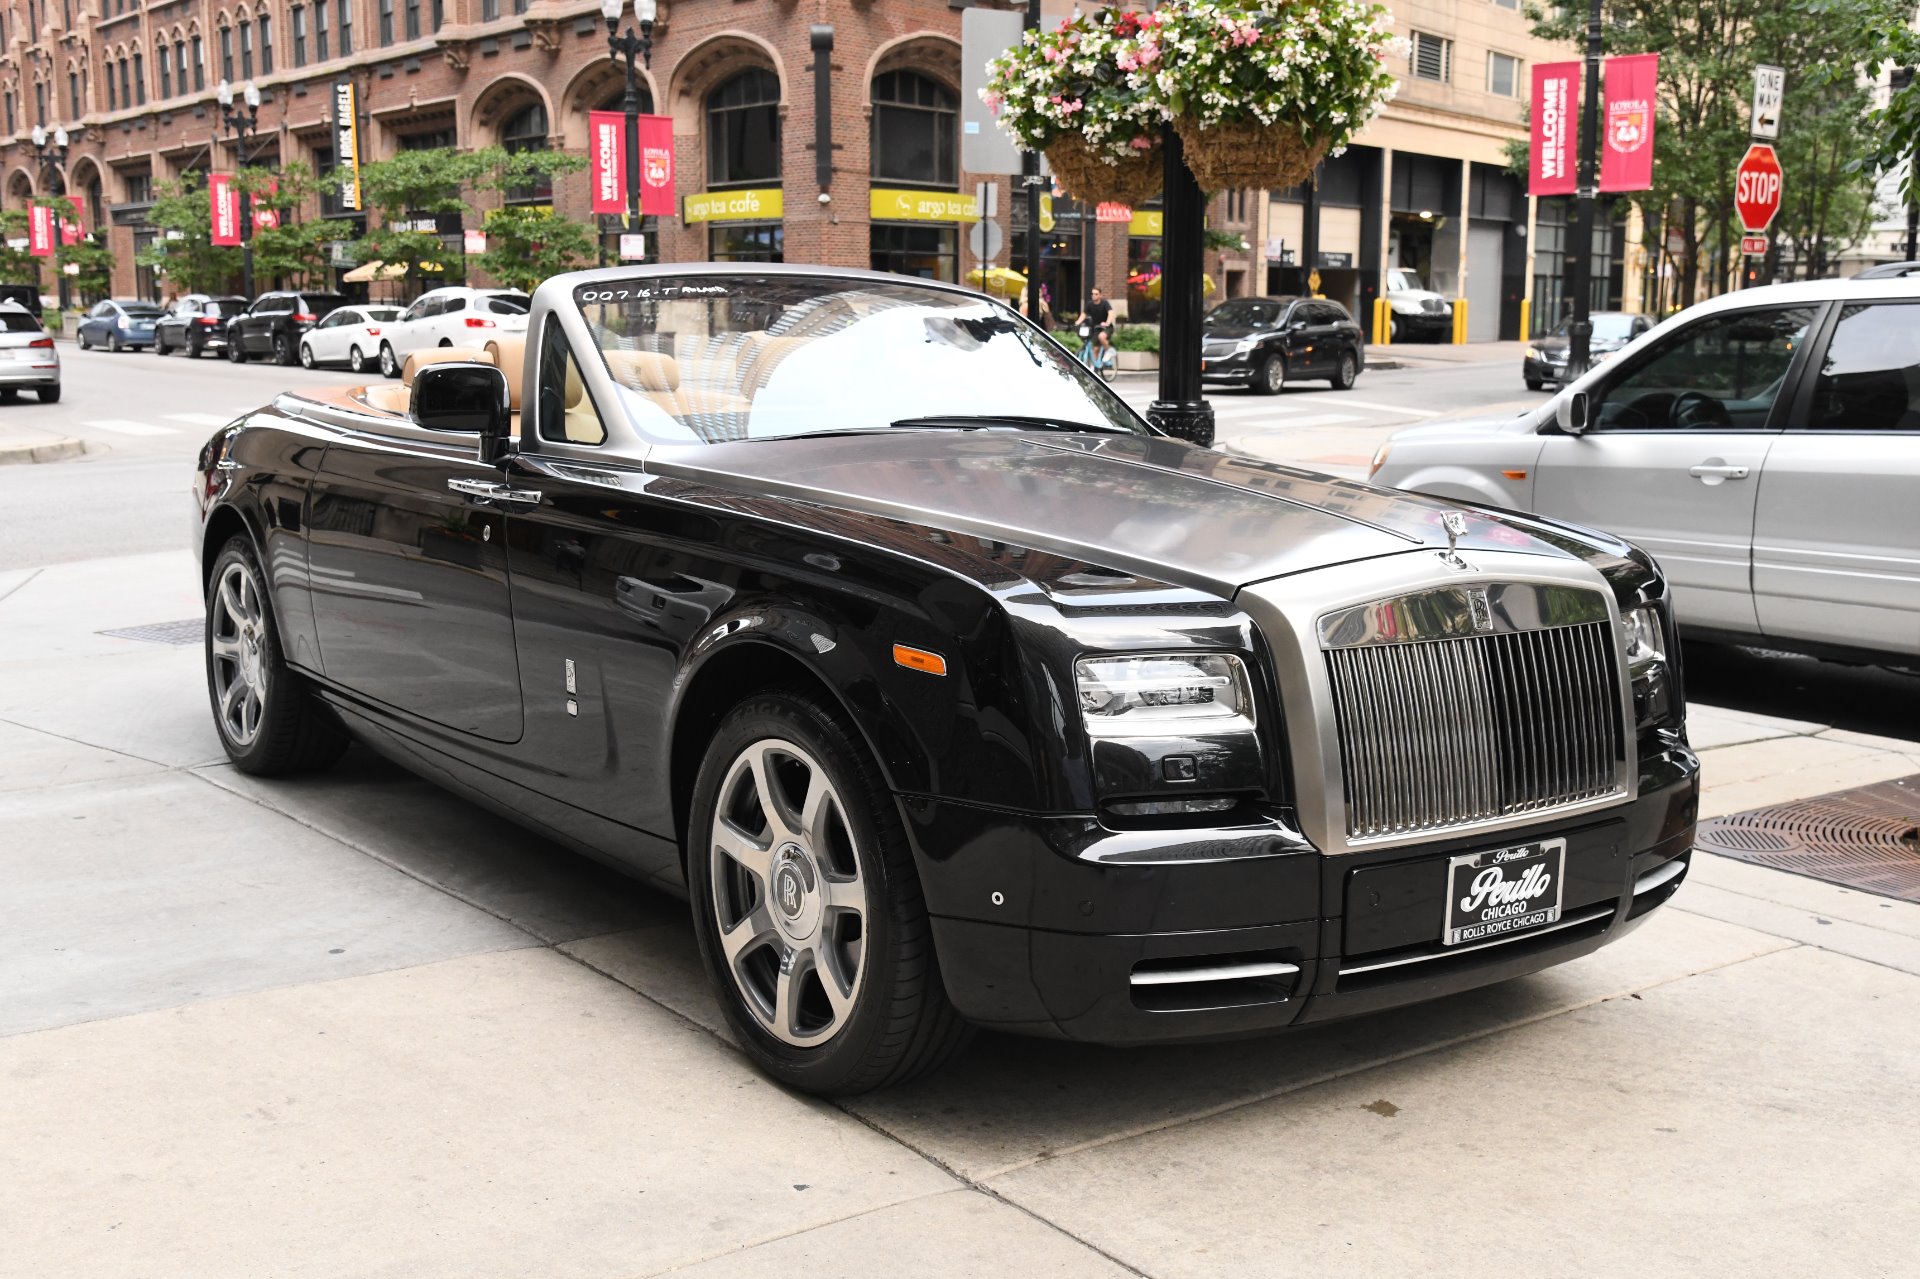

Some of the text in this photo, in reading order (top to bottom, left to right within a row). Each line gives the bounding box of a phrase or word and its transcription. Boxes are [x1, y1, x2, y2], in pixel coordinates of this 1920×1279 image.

[1760, 73, 1780, 91] ONE
[337, 84, 351, 126] BAGELS
[1610, 99, 1649, 111] LOYOLA
[1758, 93, 1778, 107] WAY
[1542, 78, 1559, 179] WELCOME
[1557, 78, 1568, 178] WATER TOWER CAMPUS
[598, 124, 613, 201] WELCOME
[643, 147, 670, 158] LOYOLA
[340, 159, 356, 208] EINSN
[1738, 169, 1779, 205] STOP
[216, 182, 229, 237] WELCOME
[729, 191, 760, 212] café
[918, 196, 978, 219] argo tea caf
[1743, 240, 1753, 251] ALL
[1492, 847, 1530, 864] Perillo
[1460, 863, 1551, 913] Perillo
[1481, 900, 1527, 921] CHICAGO
[1463, 926, 1485, 940] ROLLS
[1486, 920, 1511, 934] ROYCE
[1512, 913, 1545, 928] CHICAGO
